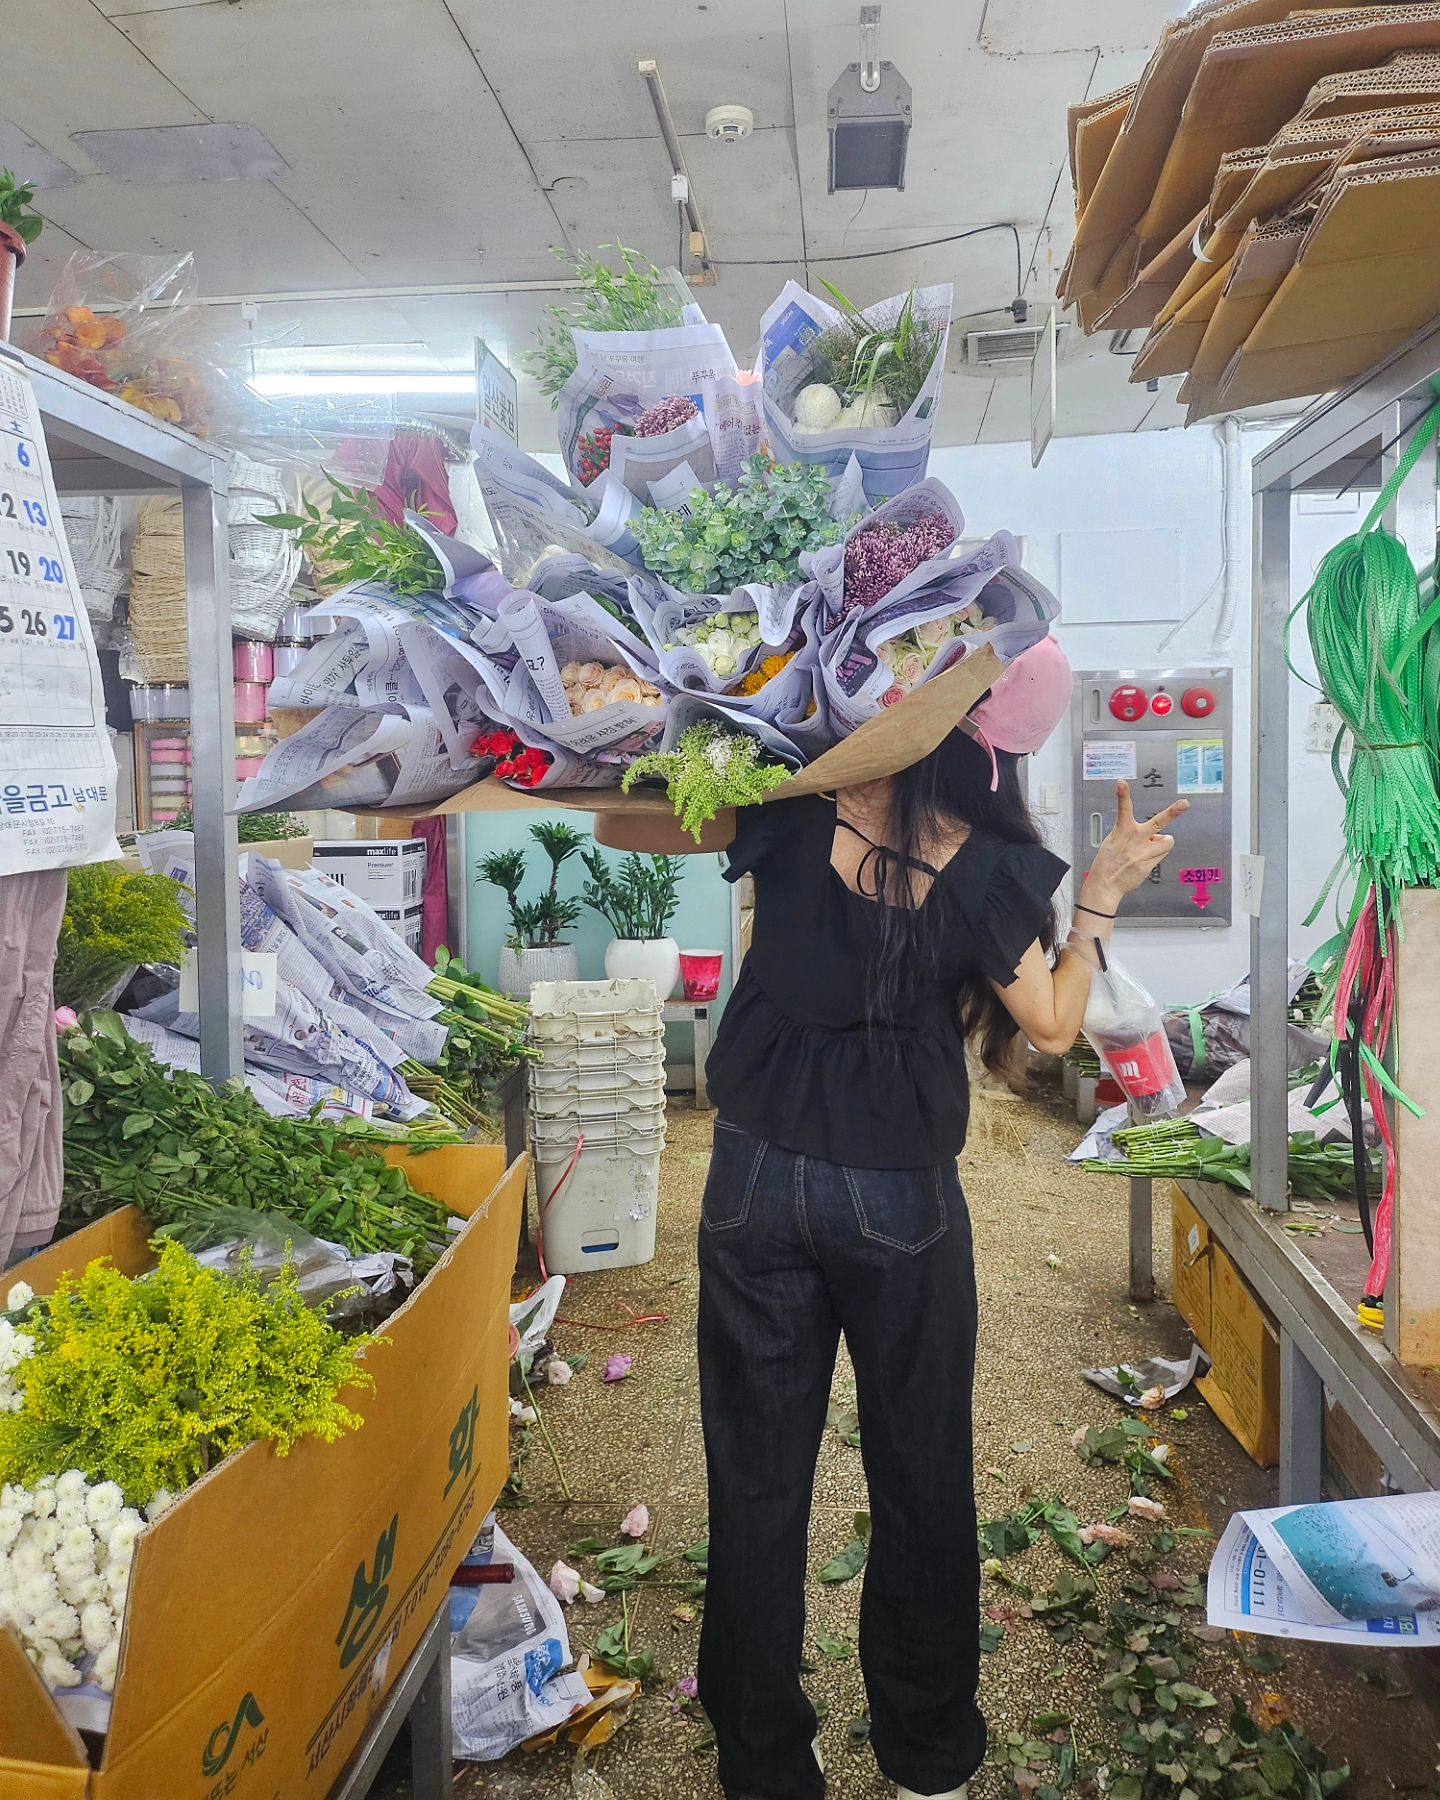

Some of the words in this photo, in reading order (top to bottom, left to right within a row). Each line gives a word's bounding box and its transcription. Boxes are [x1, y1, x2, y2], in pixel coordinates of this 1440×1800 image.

[482, 375, 516, 434] 일산꽃집
[17, 442, 30, 467] 6
[0, 492, 18, 519] 2
[22, 499, 47, 527] 13
[6, 550, 31, 577] 19
[38, 556, 64, 584] 20
[21, 608, 47, 637] 26
[53, 614, 75, 640] 27
[0, 784, 72, 815] 을금고
[73, 786, 108, 803] 남대문
[366, 847, 397, 856] maxlife
[1183, 868, 1219, 883] 소화기
[512, 1594, 537, 1636] SAMSUNG
